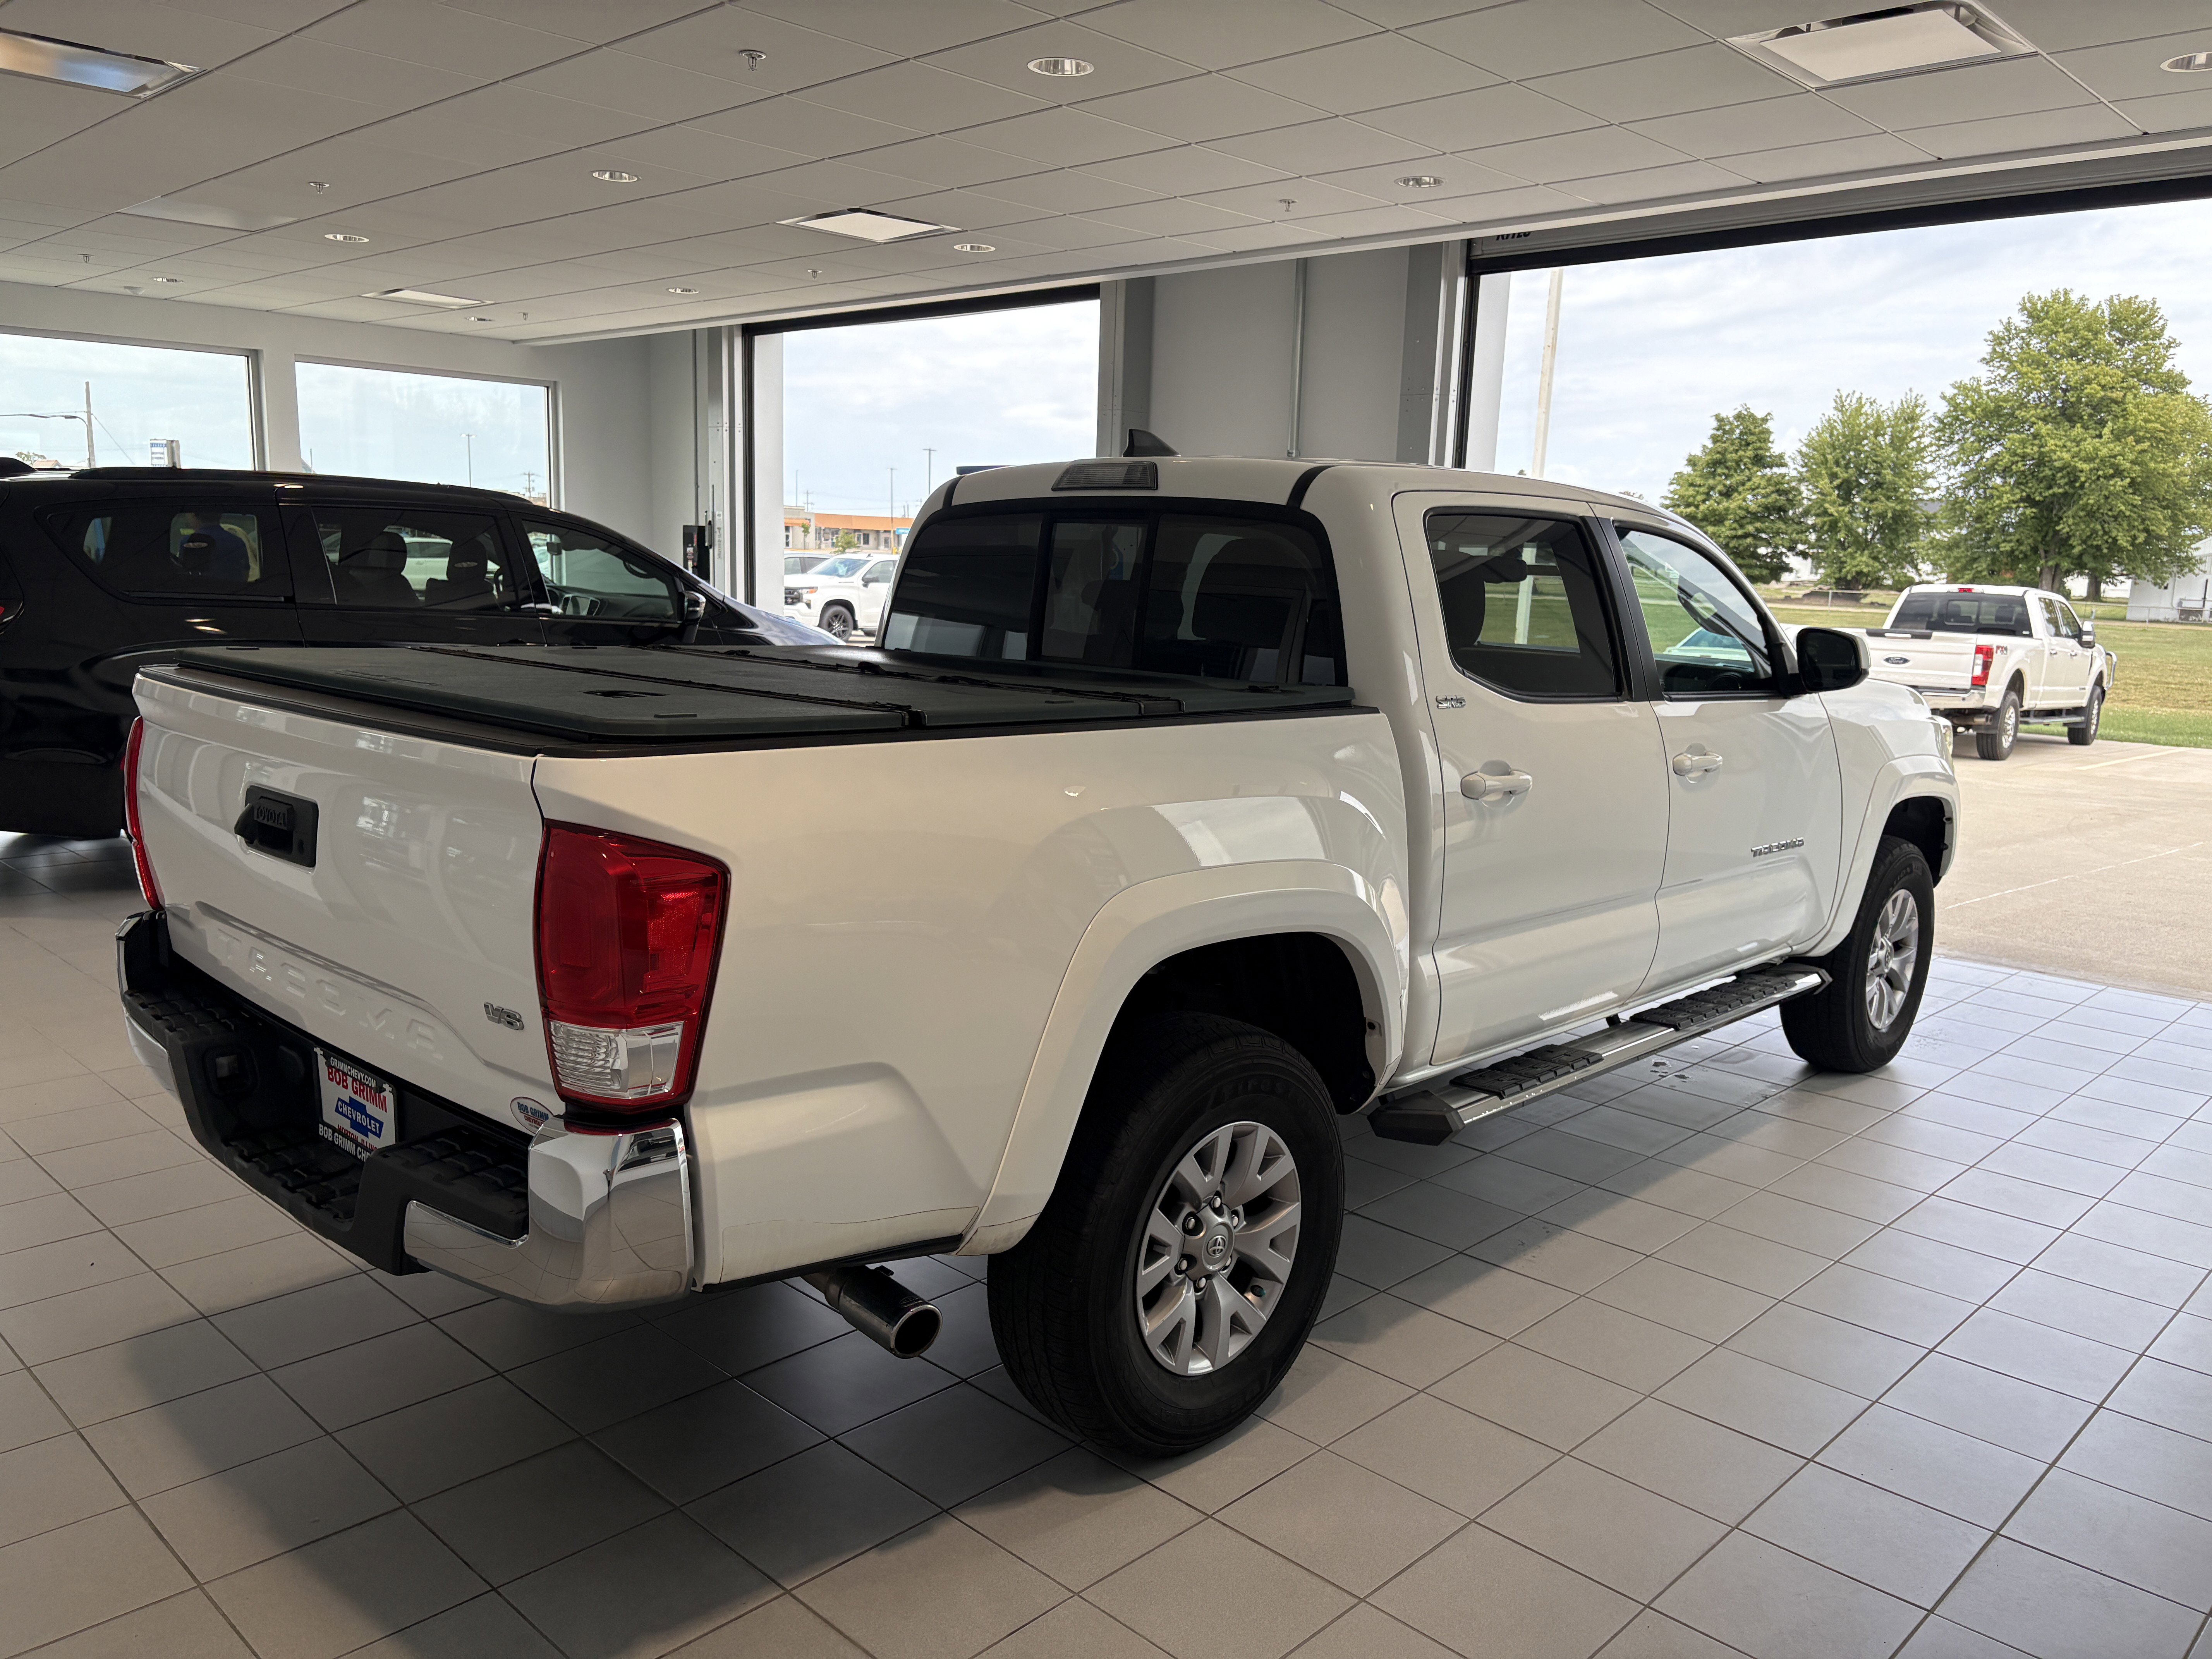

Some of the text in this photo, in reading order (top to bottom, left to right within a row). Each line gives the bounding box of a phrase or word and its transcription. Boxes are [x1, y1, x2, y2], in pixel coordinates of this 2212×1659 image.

[1751, 837, 1804, 857] TACOMA
[484, 1002, 524, 1030] V6
[330, 1057, 376, 1087] GRIMMCHEVY.COM
[327, 1066, 387, 1113] BOB GRIMM
[338, 1101, 380, 1134] CHEVROLET
[517, 1101, 549, 1121] BOB GRIMM
[319, 1123, 332, 1141] BOB
[334, 1132, 356, 1156] GRIMM
